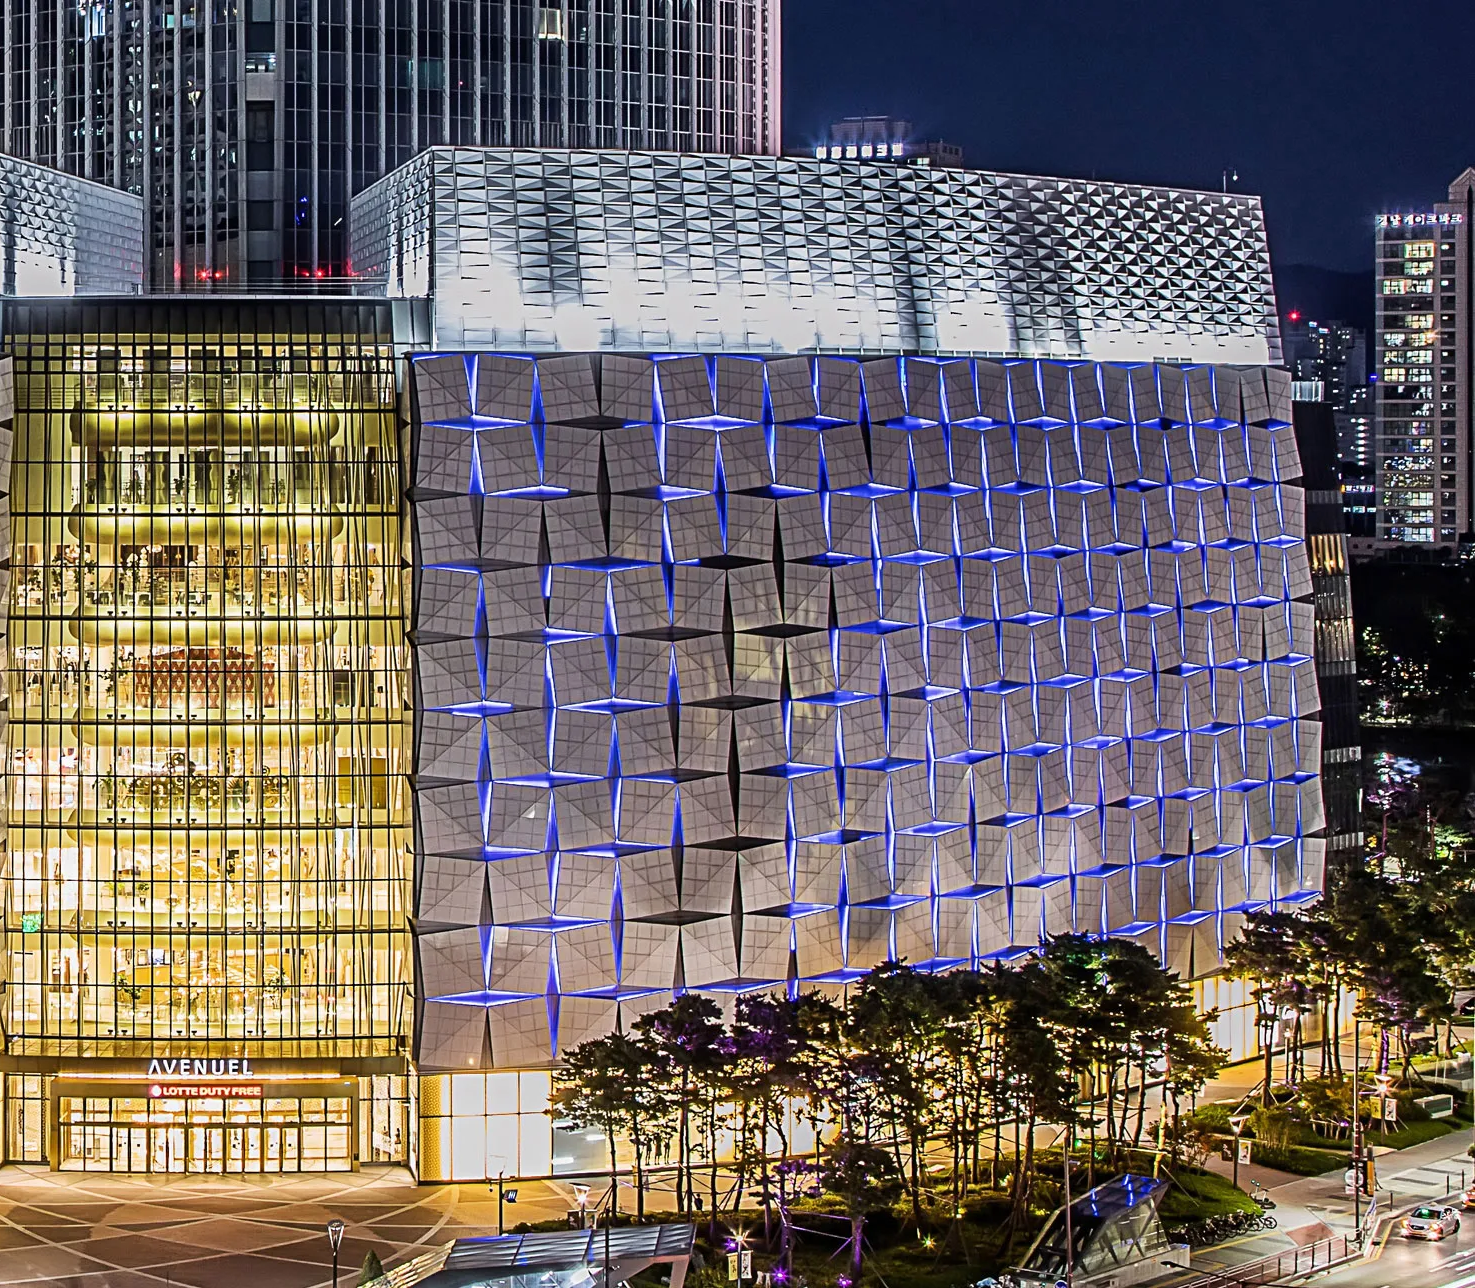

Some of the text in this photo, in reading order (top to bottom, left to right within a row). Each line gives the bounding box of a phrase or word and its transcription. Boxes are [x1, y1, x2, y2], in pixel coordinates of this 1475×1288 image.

[148, 1058, 254, 1076] AVENUEL
[162, 1086, 262, 1096] LOTTE DUTY FREE
